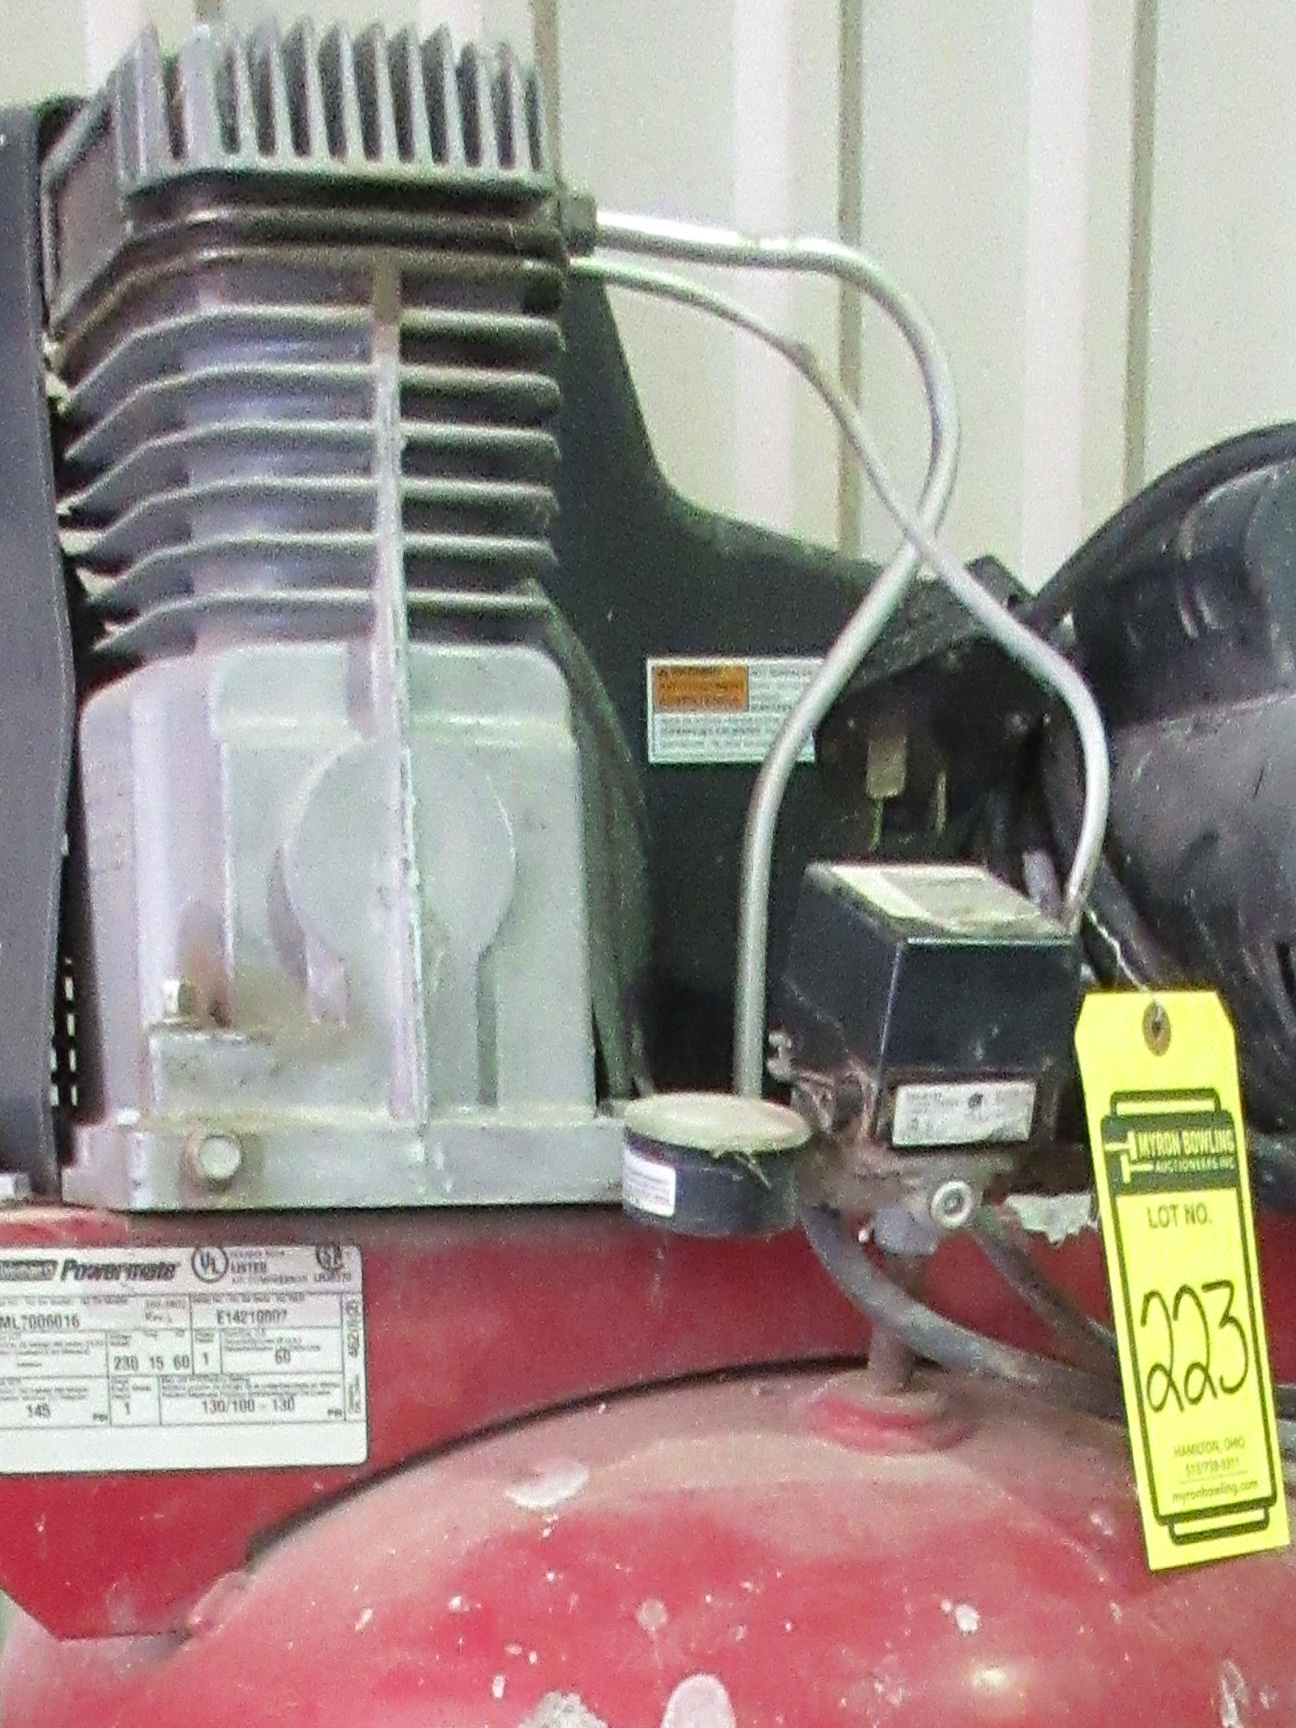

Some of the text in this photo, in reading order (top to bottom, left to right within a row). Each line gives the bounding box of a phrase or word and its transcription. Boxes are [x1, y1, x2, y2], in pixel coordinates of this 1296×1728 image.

[1137, 1128, 1236, 1160] MYRON BOWLING
[1147, 1201, 1212, 1229] LOT NO.
[61, 1258, 178, 1282] Powermate
[1140, 1279, 1249, 1413] 223
[114, 1353, 191, 1372] 230 15 60
[203, 1351, 210, 1366] 1
[274, 1350, 292, 1366] 60
[26, 1402, 51, 1419] 145
[123, 1402, 131, 1416] 1
[272, 1395, 296, 1412] 130
[1223, 1435, 1246, 1451] OHIO
[1172, 1478, 1259, 1505] myronbowling.com
